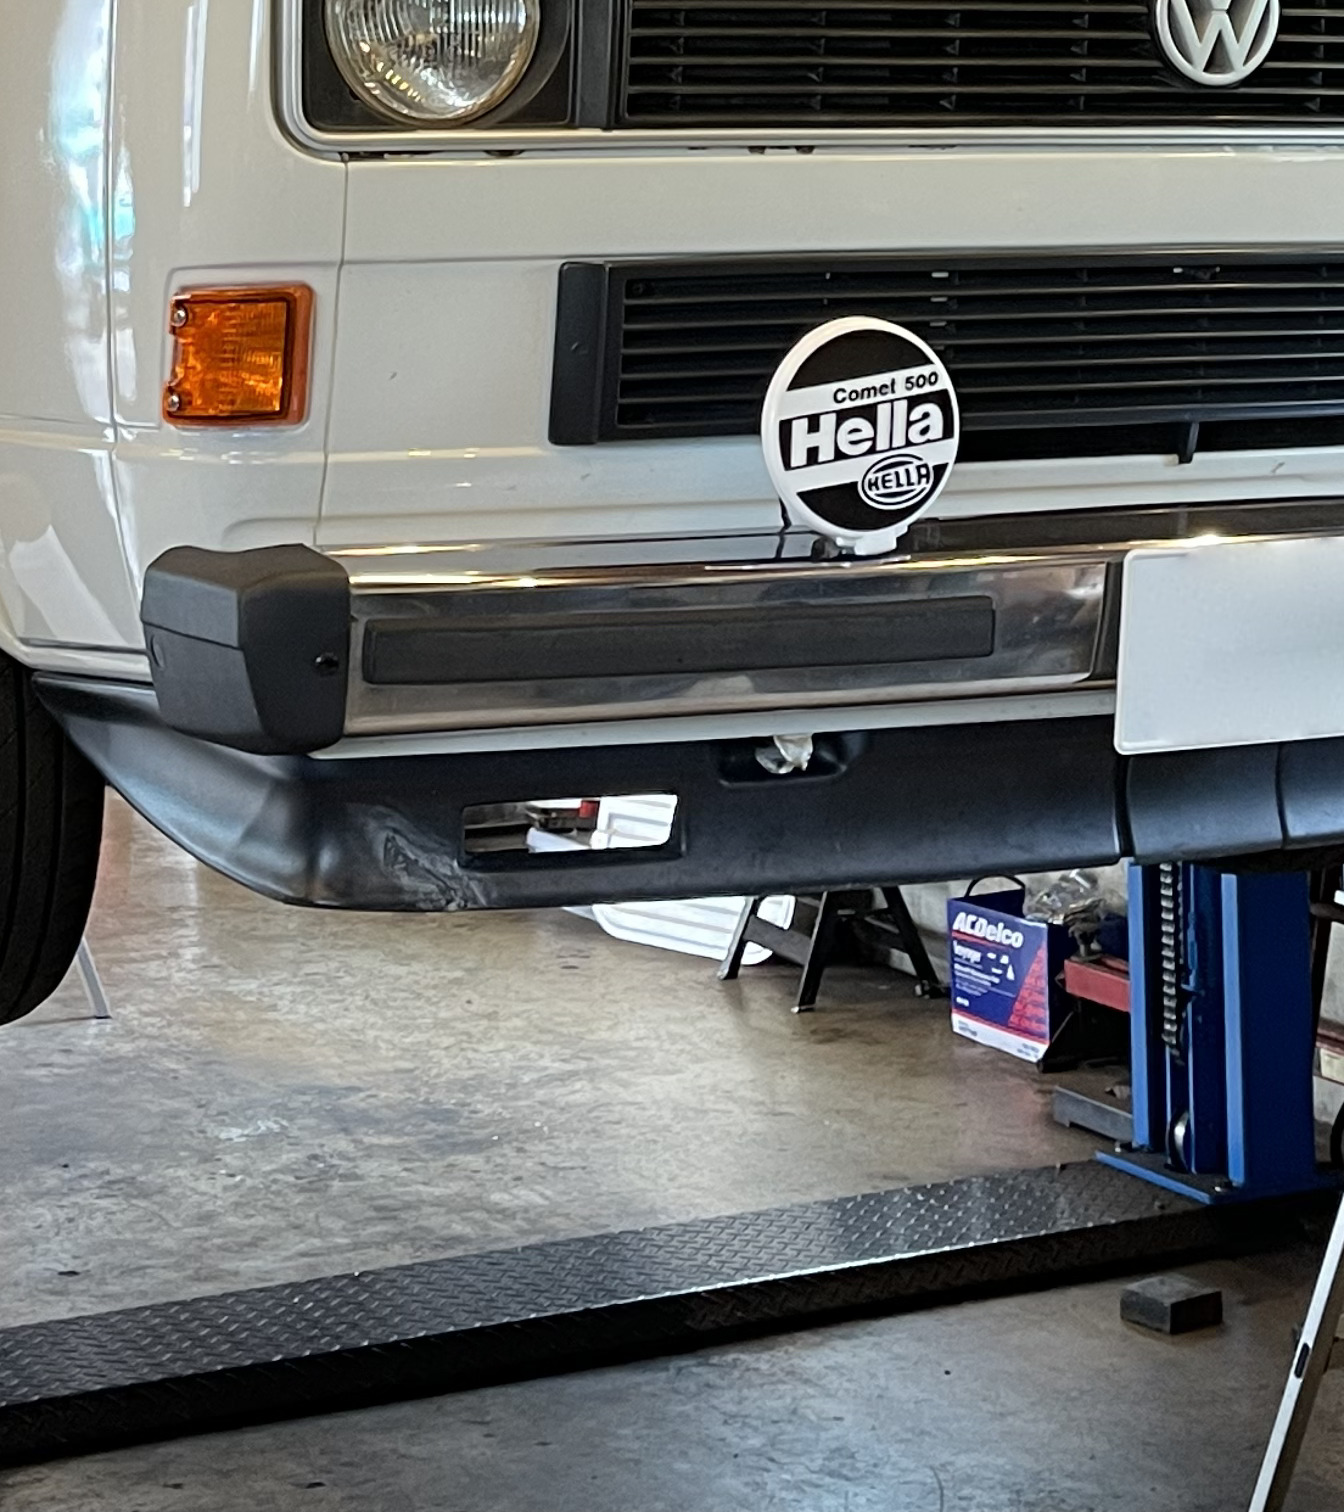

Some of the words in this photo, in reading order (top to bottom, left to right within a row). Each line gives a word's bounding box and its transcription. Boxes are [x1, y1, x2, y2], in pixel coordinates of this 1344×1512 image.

[832, 378, 897, 405] Comet
[904, 371, 940, 393] 500
[789, 398, 945, 469] Hella
[867, 462, 931, 494] HELLA
[952, 910, 1025, 949] ACDelco
